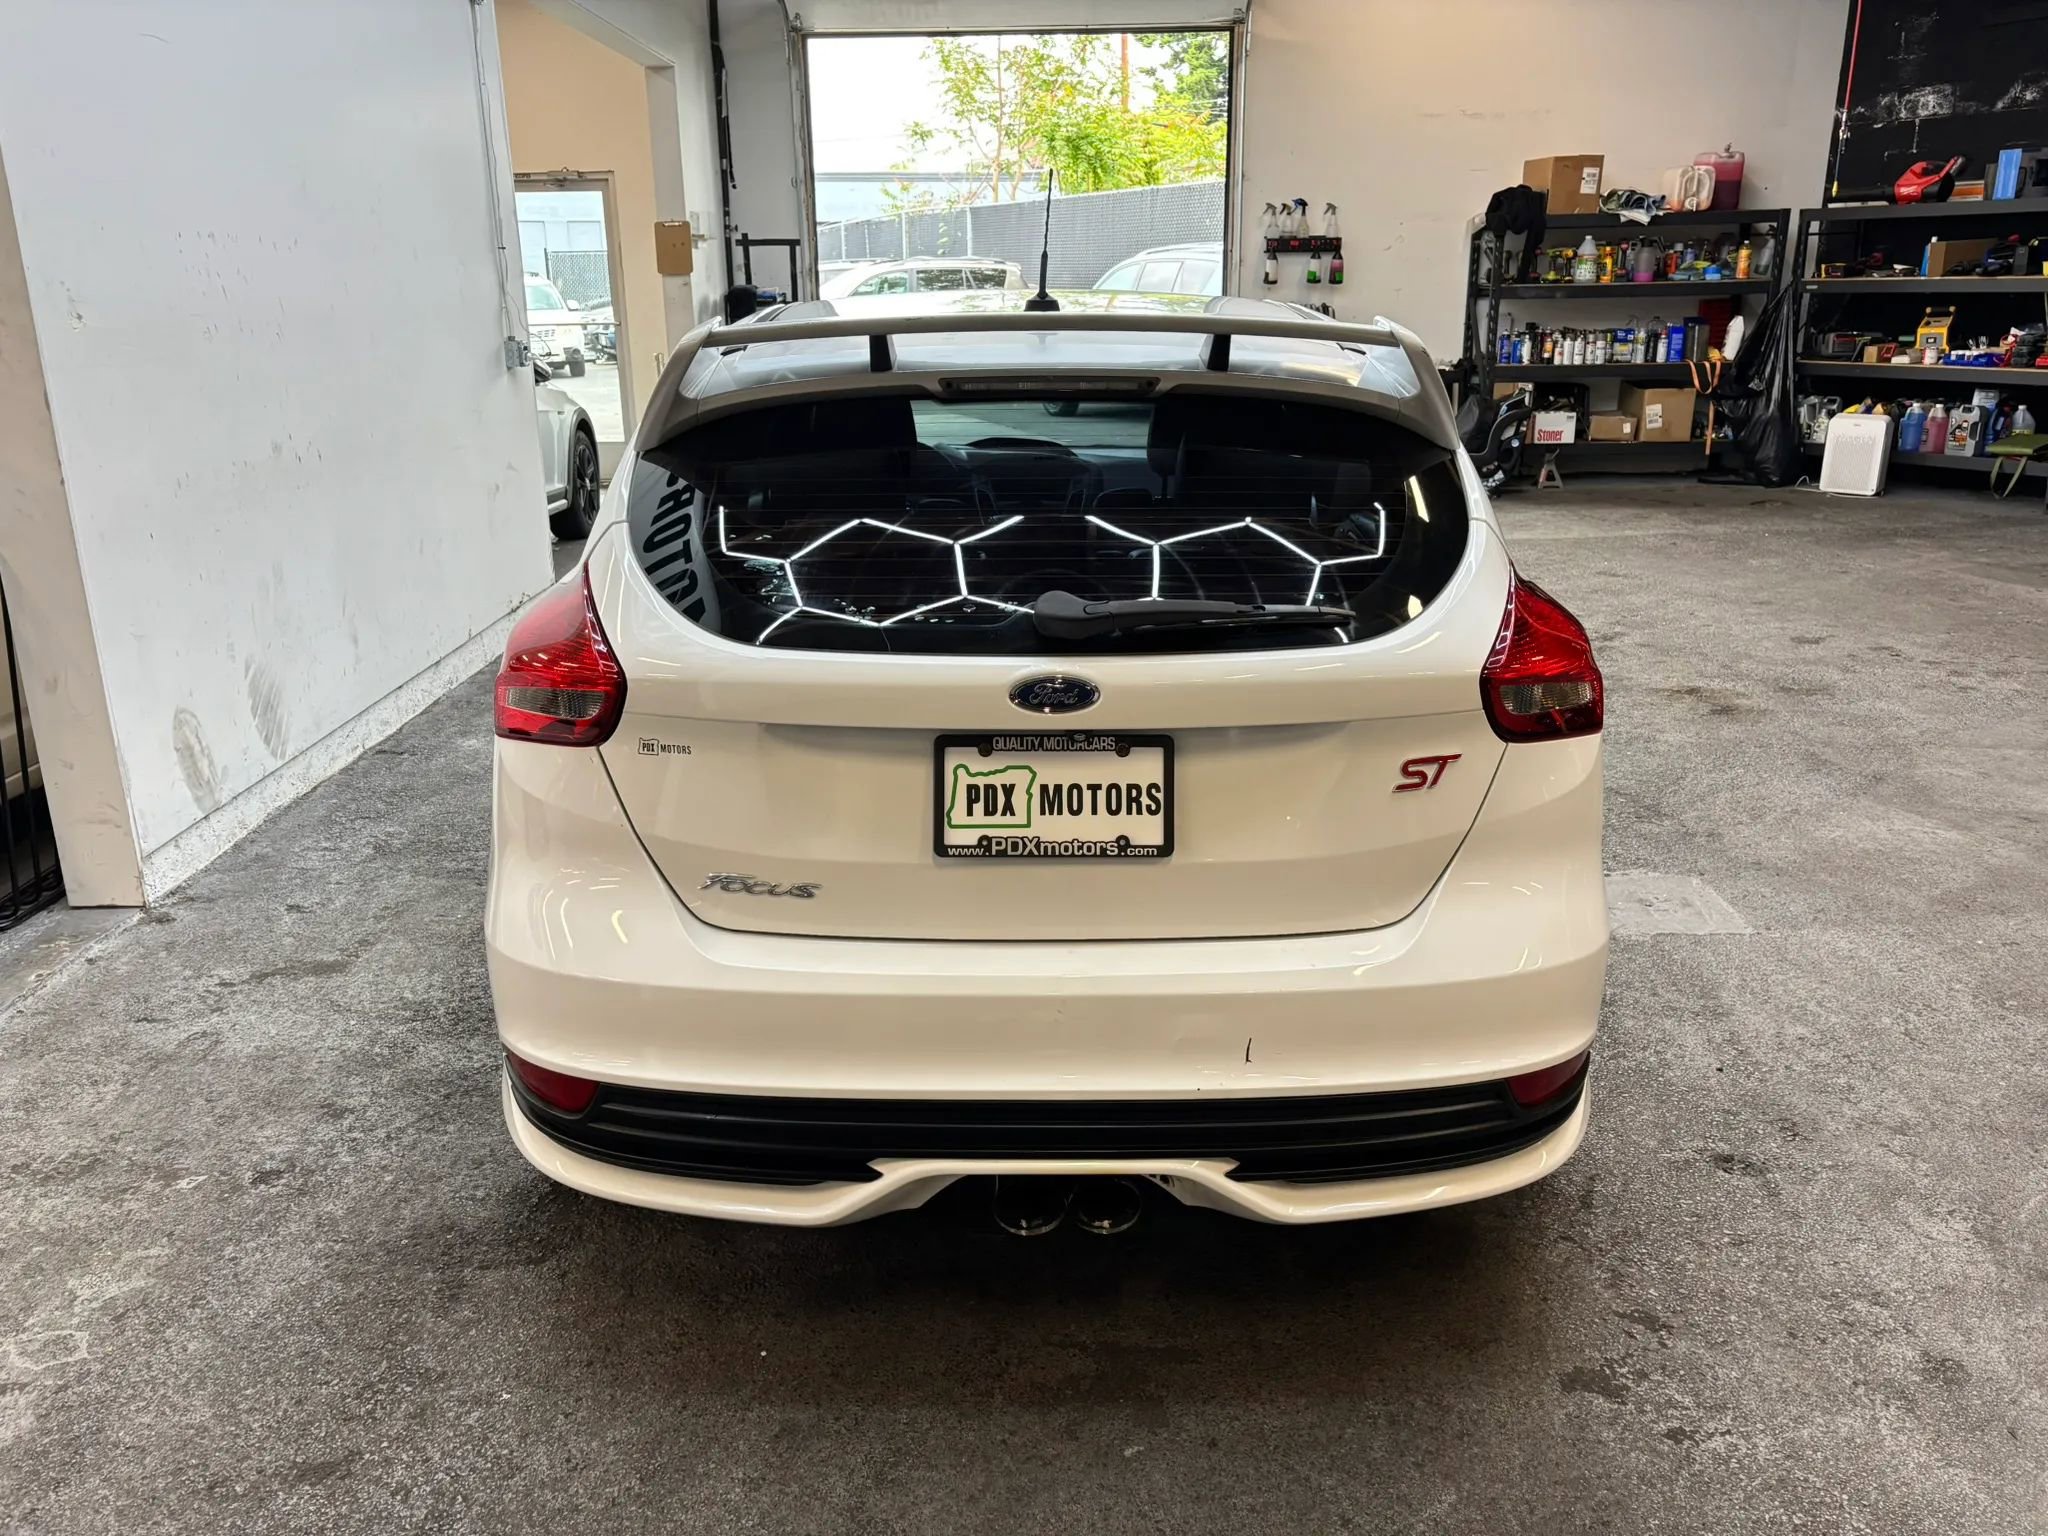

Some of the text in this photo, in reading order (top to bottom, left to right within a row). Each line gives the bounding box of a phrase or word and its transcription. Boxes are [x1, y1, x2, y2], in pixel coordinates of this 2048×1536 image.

[1537, 428, 1564, 442] Stoner
[1029, 683, 1079, 704] Ford
[660, 743, 692, 755] MOTORS
[993, 737, 1040, 750] QUALITY
[1392, 753, 1462, 793] ST
[966, 783, 1162, 817] PDX MOTORS
[947, 837, 1158, 857] www.PDXmotors.com
